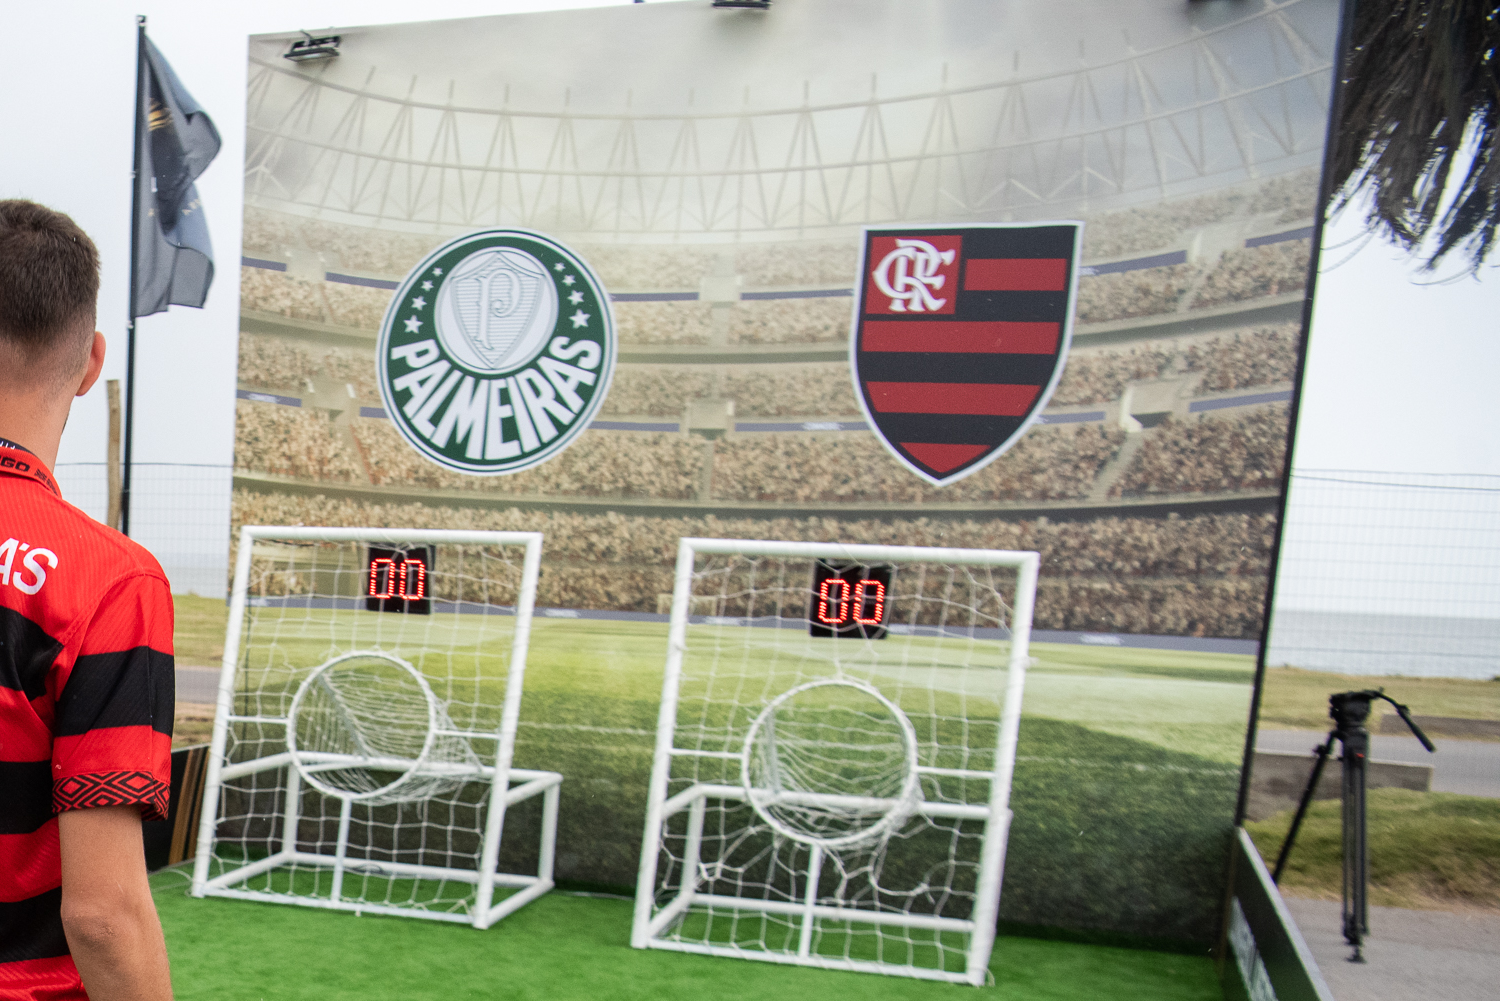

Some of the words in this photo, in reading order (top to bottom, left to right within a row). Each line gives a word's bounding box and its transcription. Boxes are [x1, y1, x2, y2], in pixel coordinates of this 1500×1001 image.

[390, 335, 602, 461] PALMEIRAS
[369, 557, 425, 600] 00
[817, 577, 885, 625] 00
